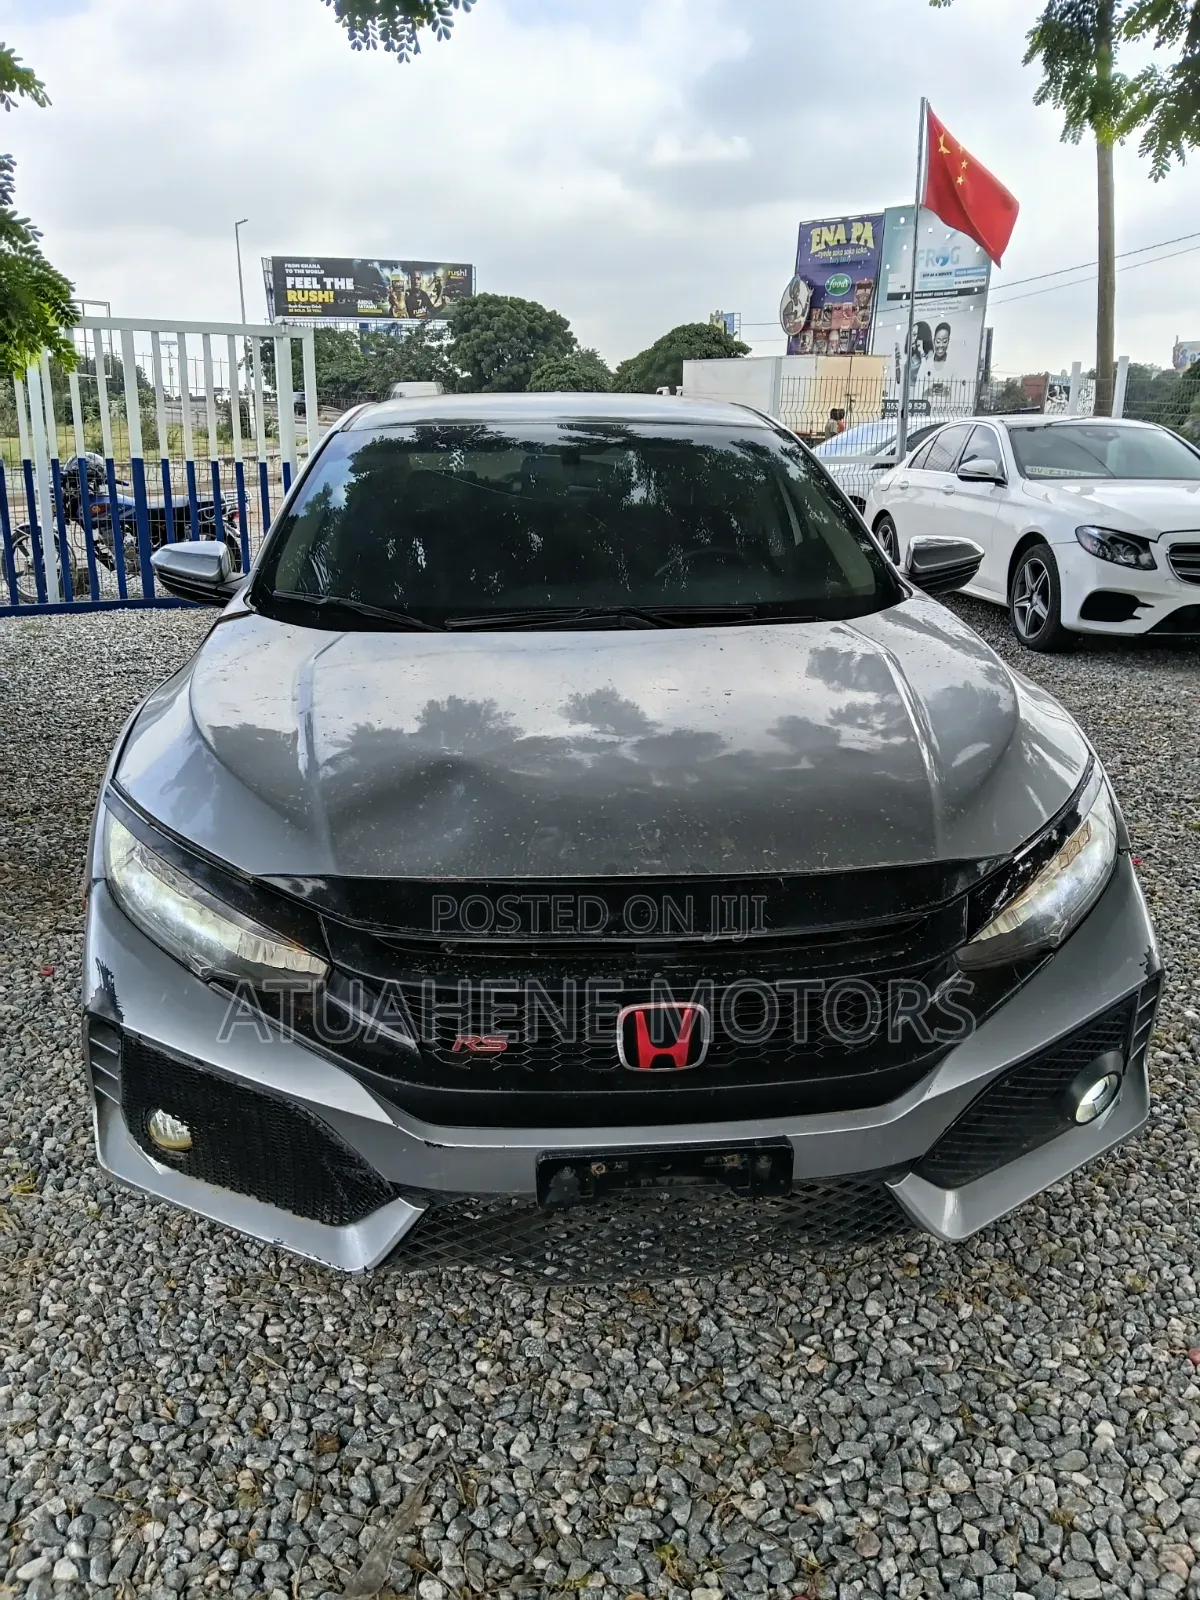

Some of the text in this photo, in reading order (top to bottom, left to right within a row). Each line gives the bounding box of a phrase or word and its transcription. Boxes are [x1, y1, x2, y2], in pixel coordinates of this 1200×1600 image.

[810, 221, 875, 254] ENA PA
[286, 276, 355, 290] FEEL THE
[286, 289, 334, 303] RUSH!
[452, 1034, 508, 1052] RS
